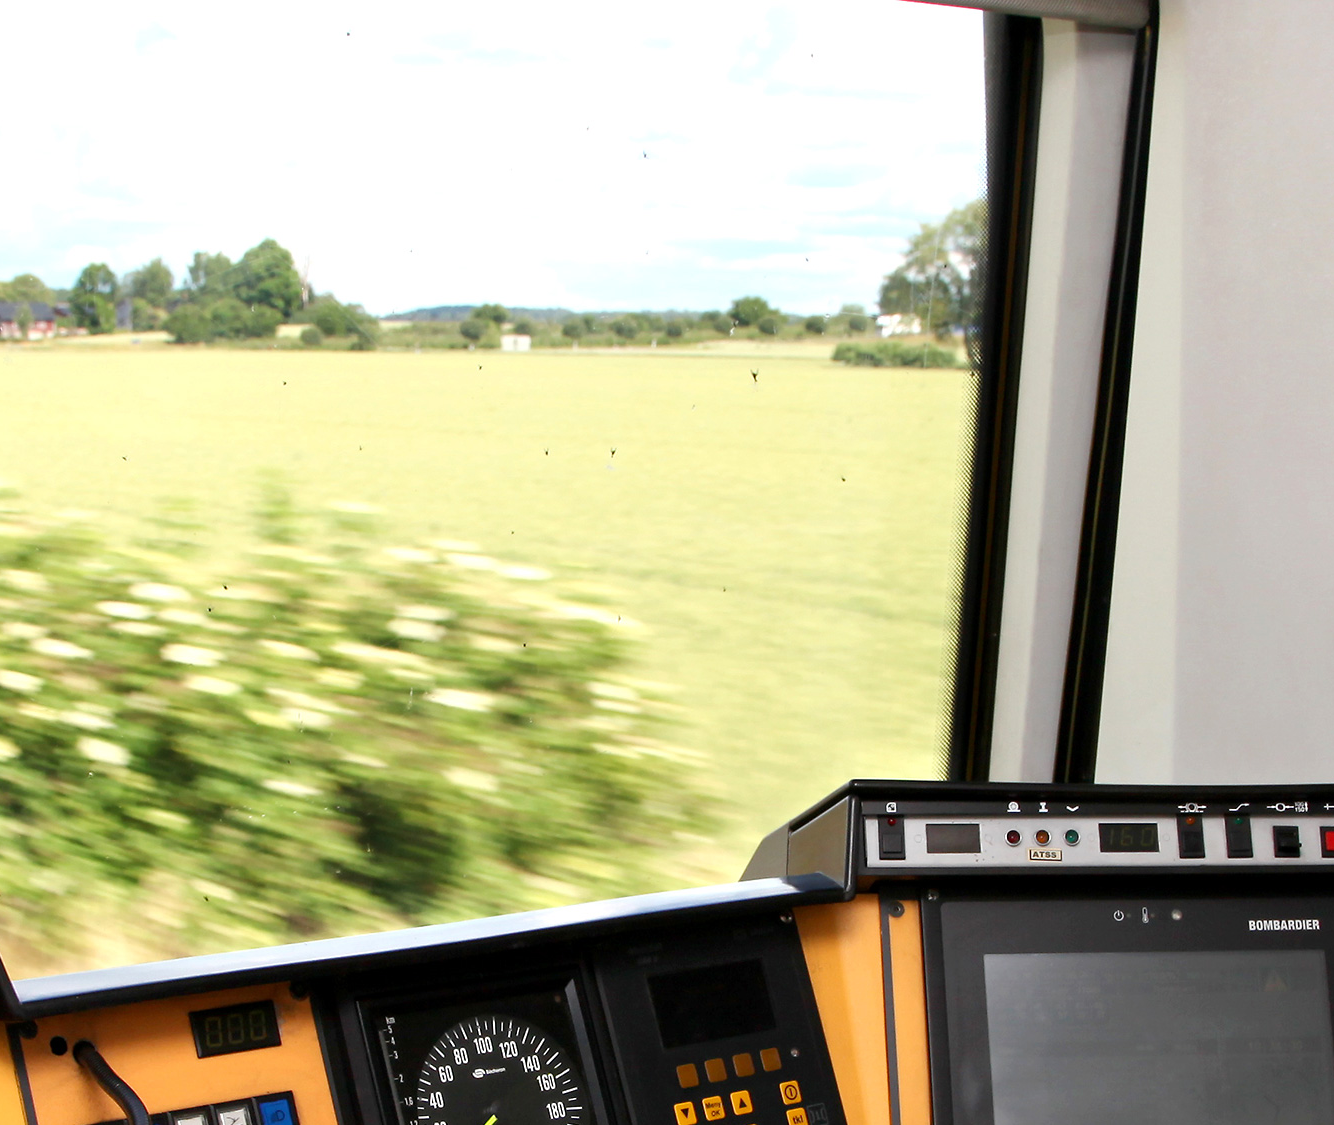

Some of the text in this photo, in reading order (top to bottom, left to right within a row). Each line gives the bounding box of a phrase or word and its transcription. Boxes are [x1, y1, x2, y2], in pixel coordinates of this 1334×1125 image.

[1248, 919, 1320, 931] BOMBARDIER
[473, 1036, 493, 1055] 100
[498, 1040, 518, 1059] 120
[453, 1047, 469, 1066] 80
[520, 1055, 541, 1073] 140
[438, 1065, 454, 1083] 60
[536, 1073, 556, 1092] 160
[429, 1091, 444, 1109] 40
[546, 1101, 566, 1120] 180
